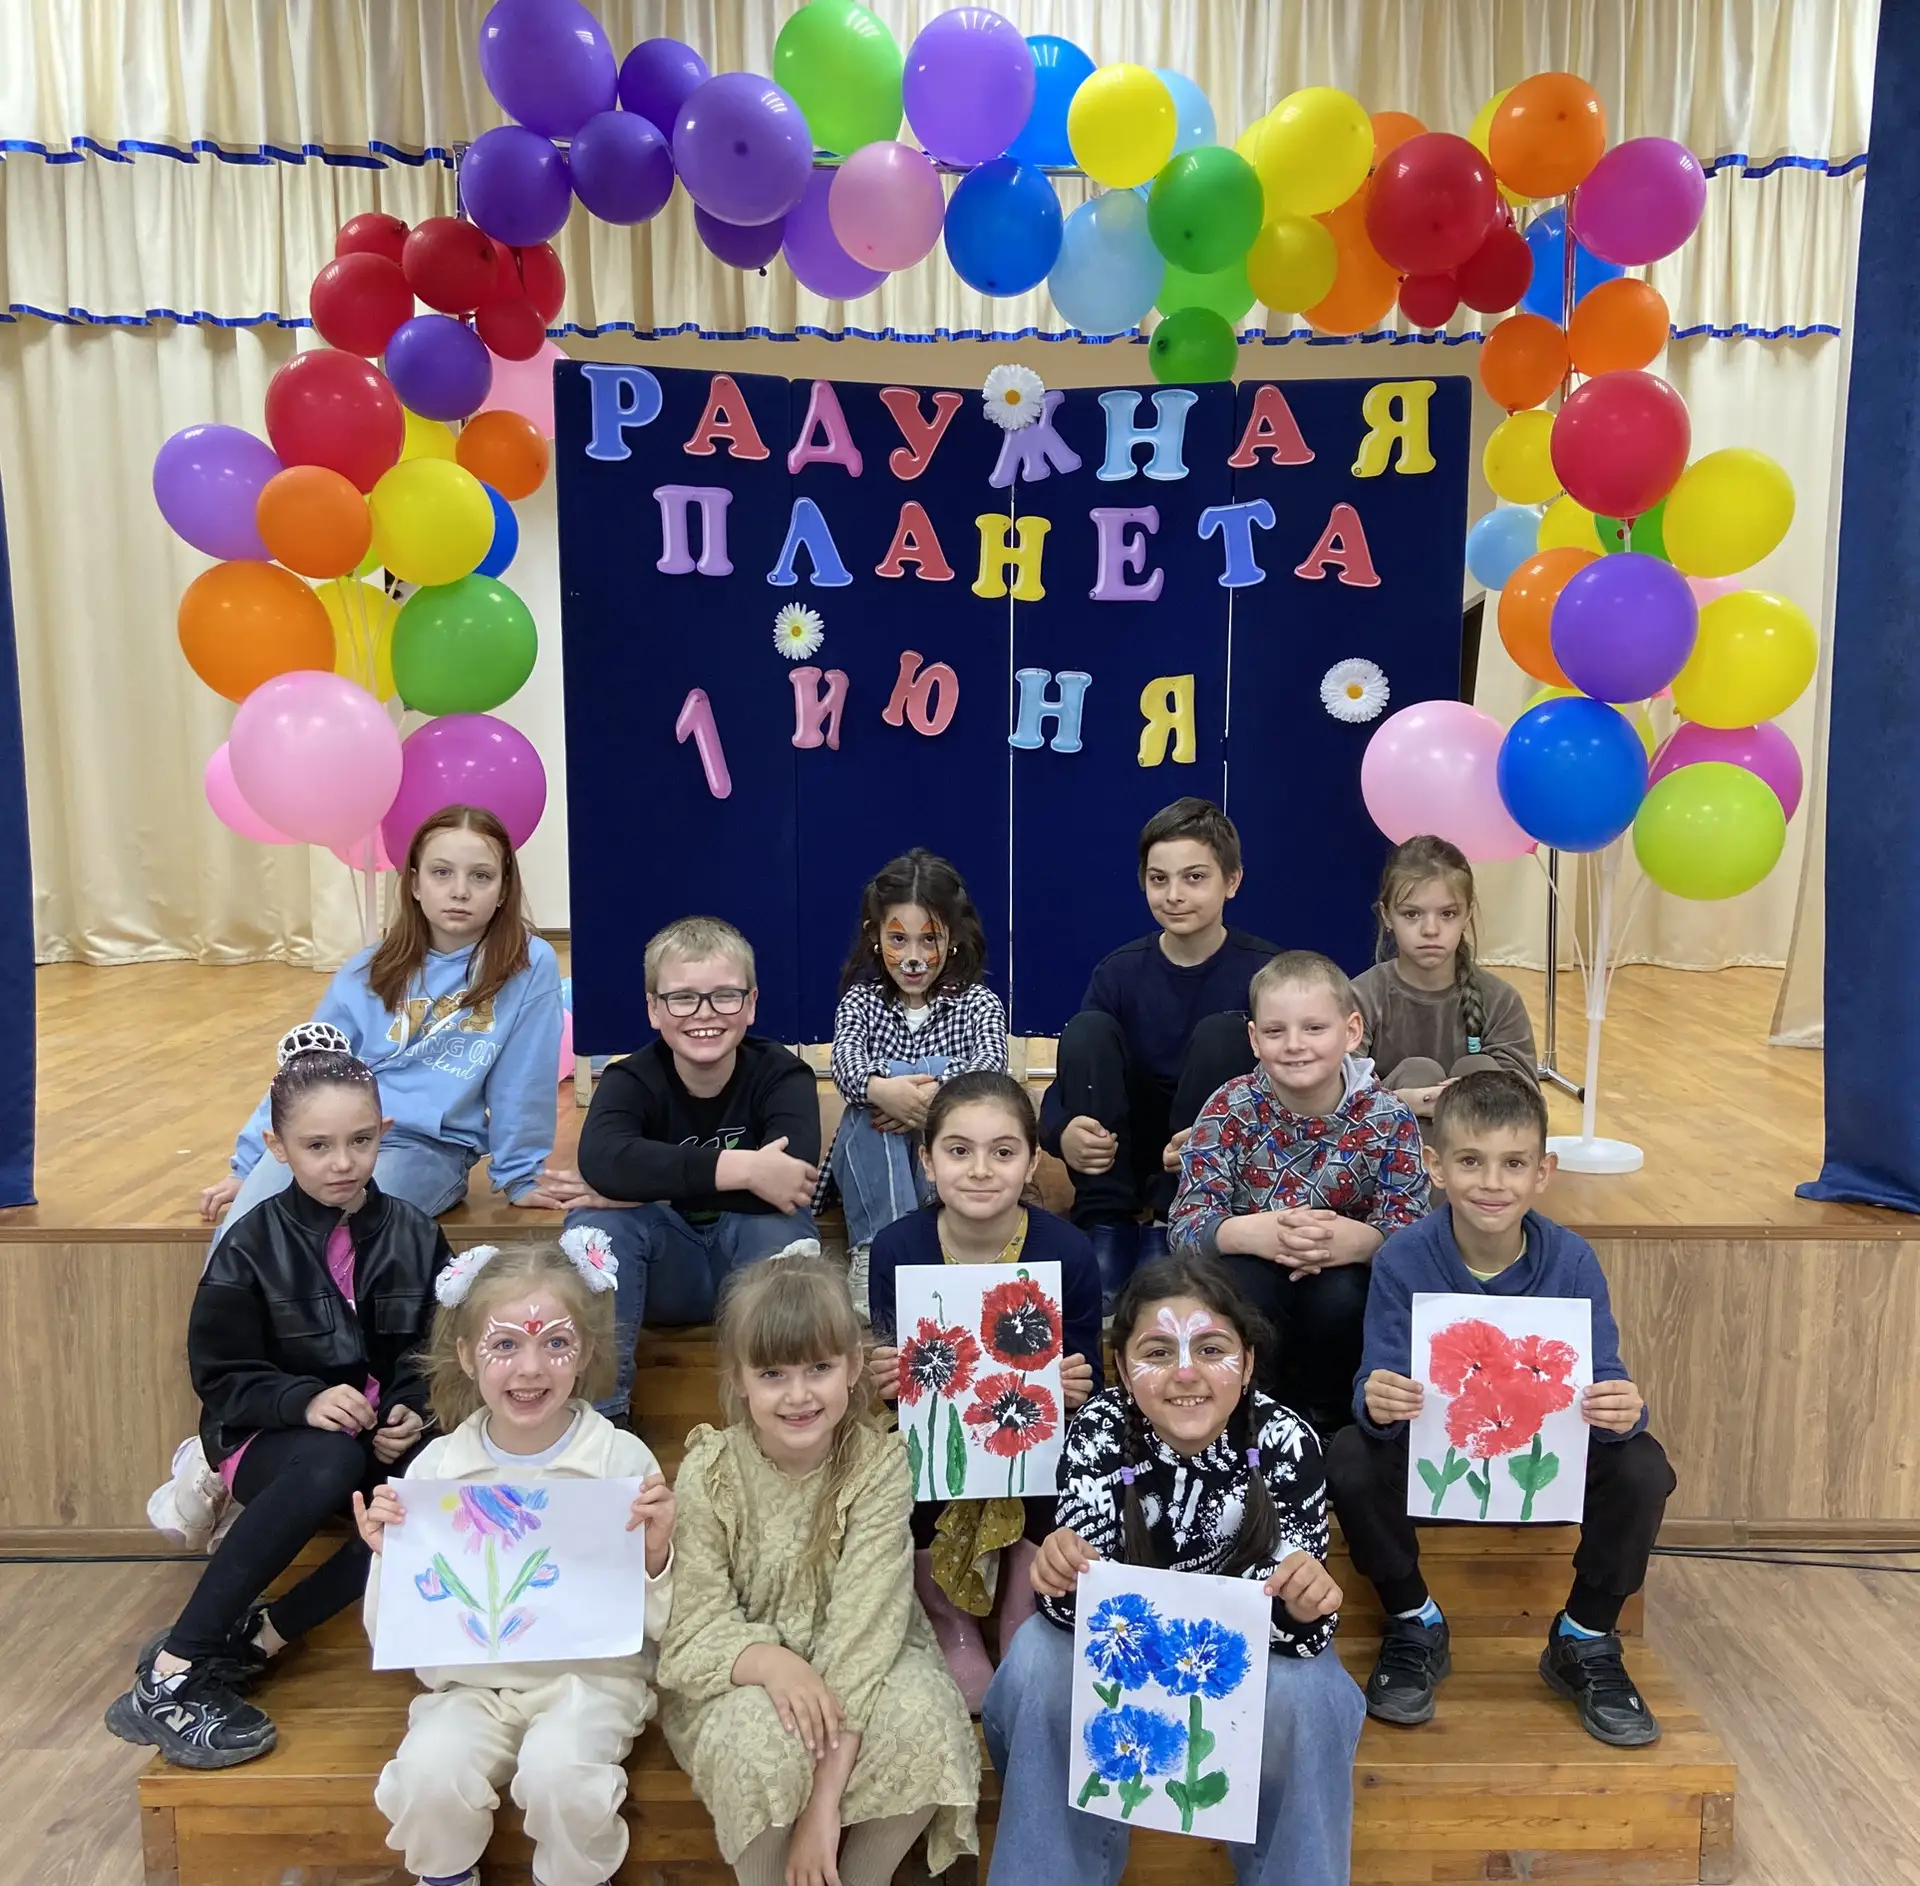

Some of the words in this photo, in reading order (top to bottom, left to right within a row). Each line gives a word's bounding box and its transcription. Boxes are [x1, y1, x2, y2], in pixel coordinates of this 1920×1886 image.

[581, 364, 1437, 488] РАДУЖНАЯ
[653, 484, 1381, 601] ПЛАНЕТА
[676, 688, 732, 799] 1
[788, 650, 1196, 767] ИЮНЯ
[422, 1050, 480, 1080] ekend
